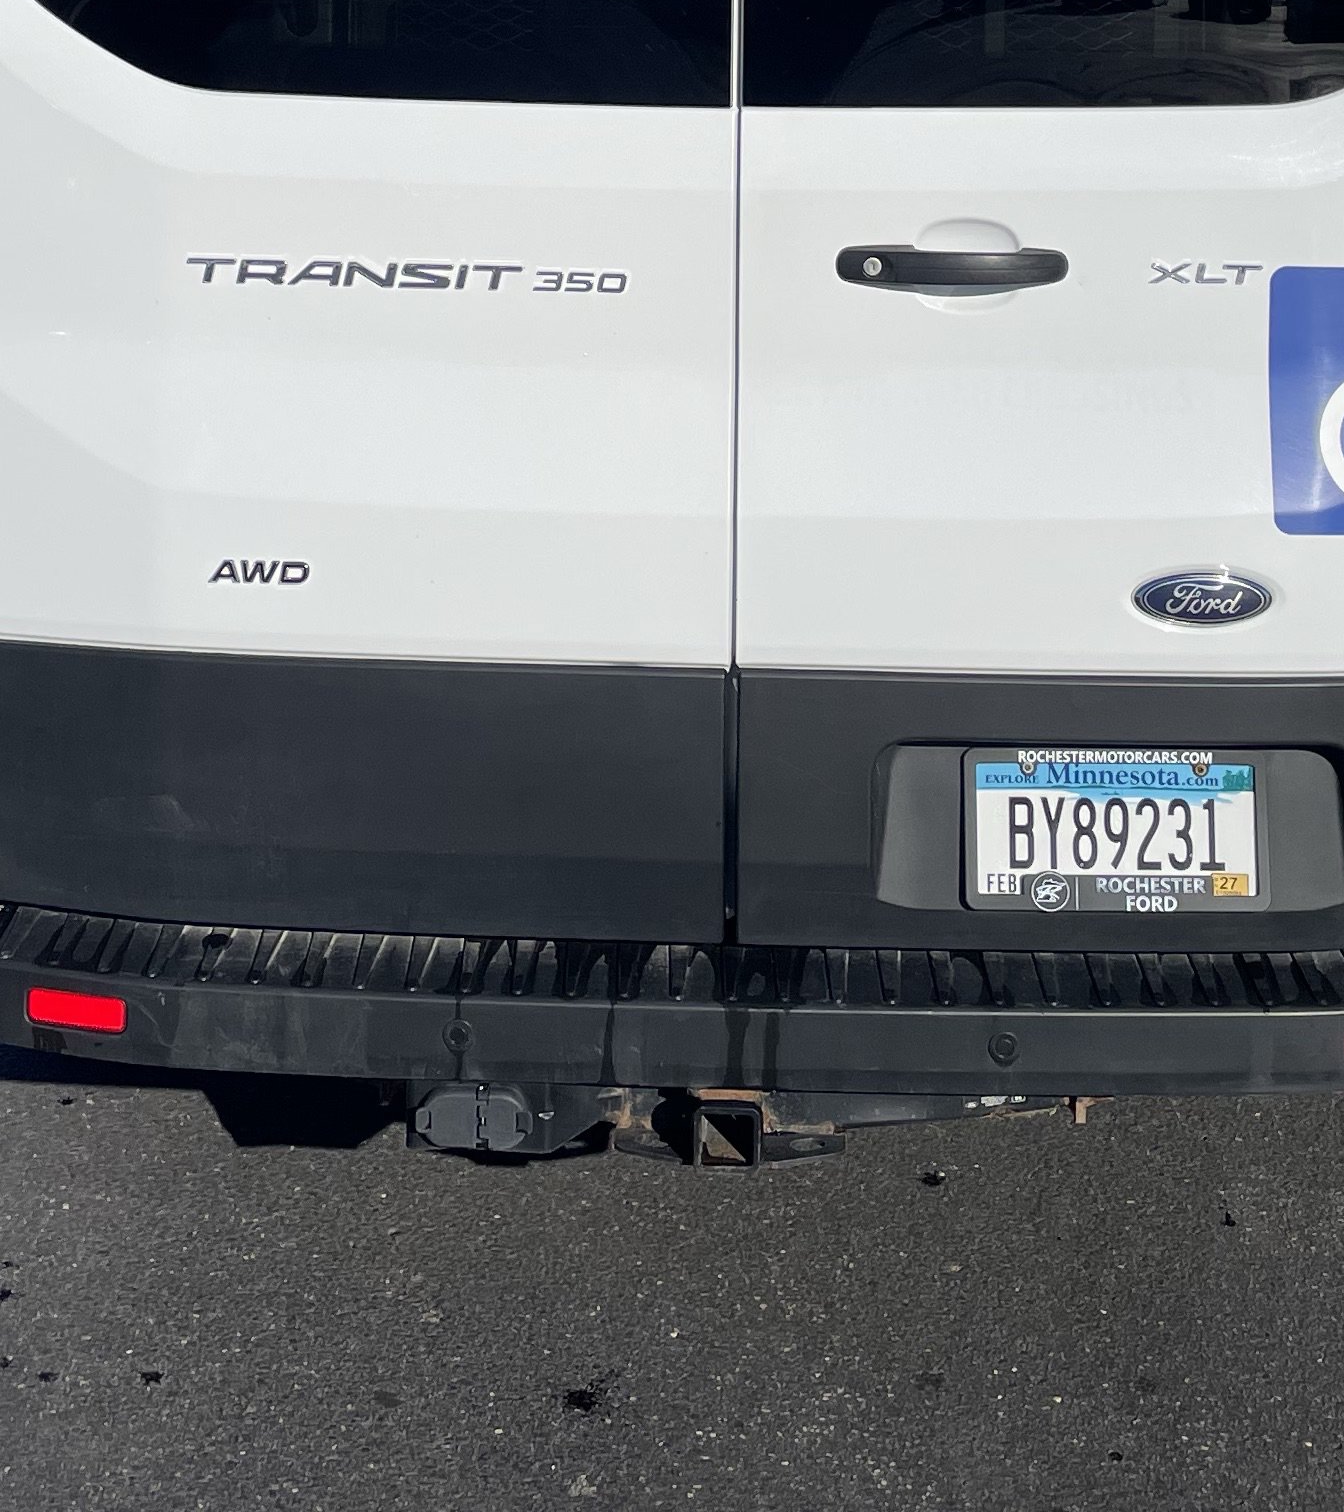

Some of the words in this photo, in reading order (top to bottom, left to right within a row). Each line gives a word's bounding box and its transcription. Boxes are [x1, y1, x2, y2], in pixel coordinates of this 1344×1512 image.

[186, 256, 524, 291] TRANSIT
[533, 270, 628, 294] 350
[1147, 262, 1264, 285] XLT
[207, 559, 311, 585] AWD
[1165, 583, 1244, 615] Ford
[1017, 750, 1213, 765] ROCHESTERMOTORCARS.COM
[1008, 796, 1226, 872] BY89231
[986, 873, 1017, 893] FEB
[1095, 877, 1207, 894] ROCHESTER
[1219, 876, 1238, 890] 27
[1126, 896, 1178, 912] FORD
